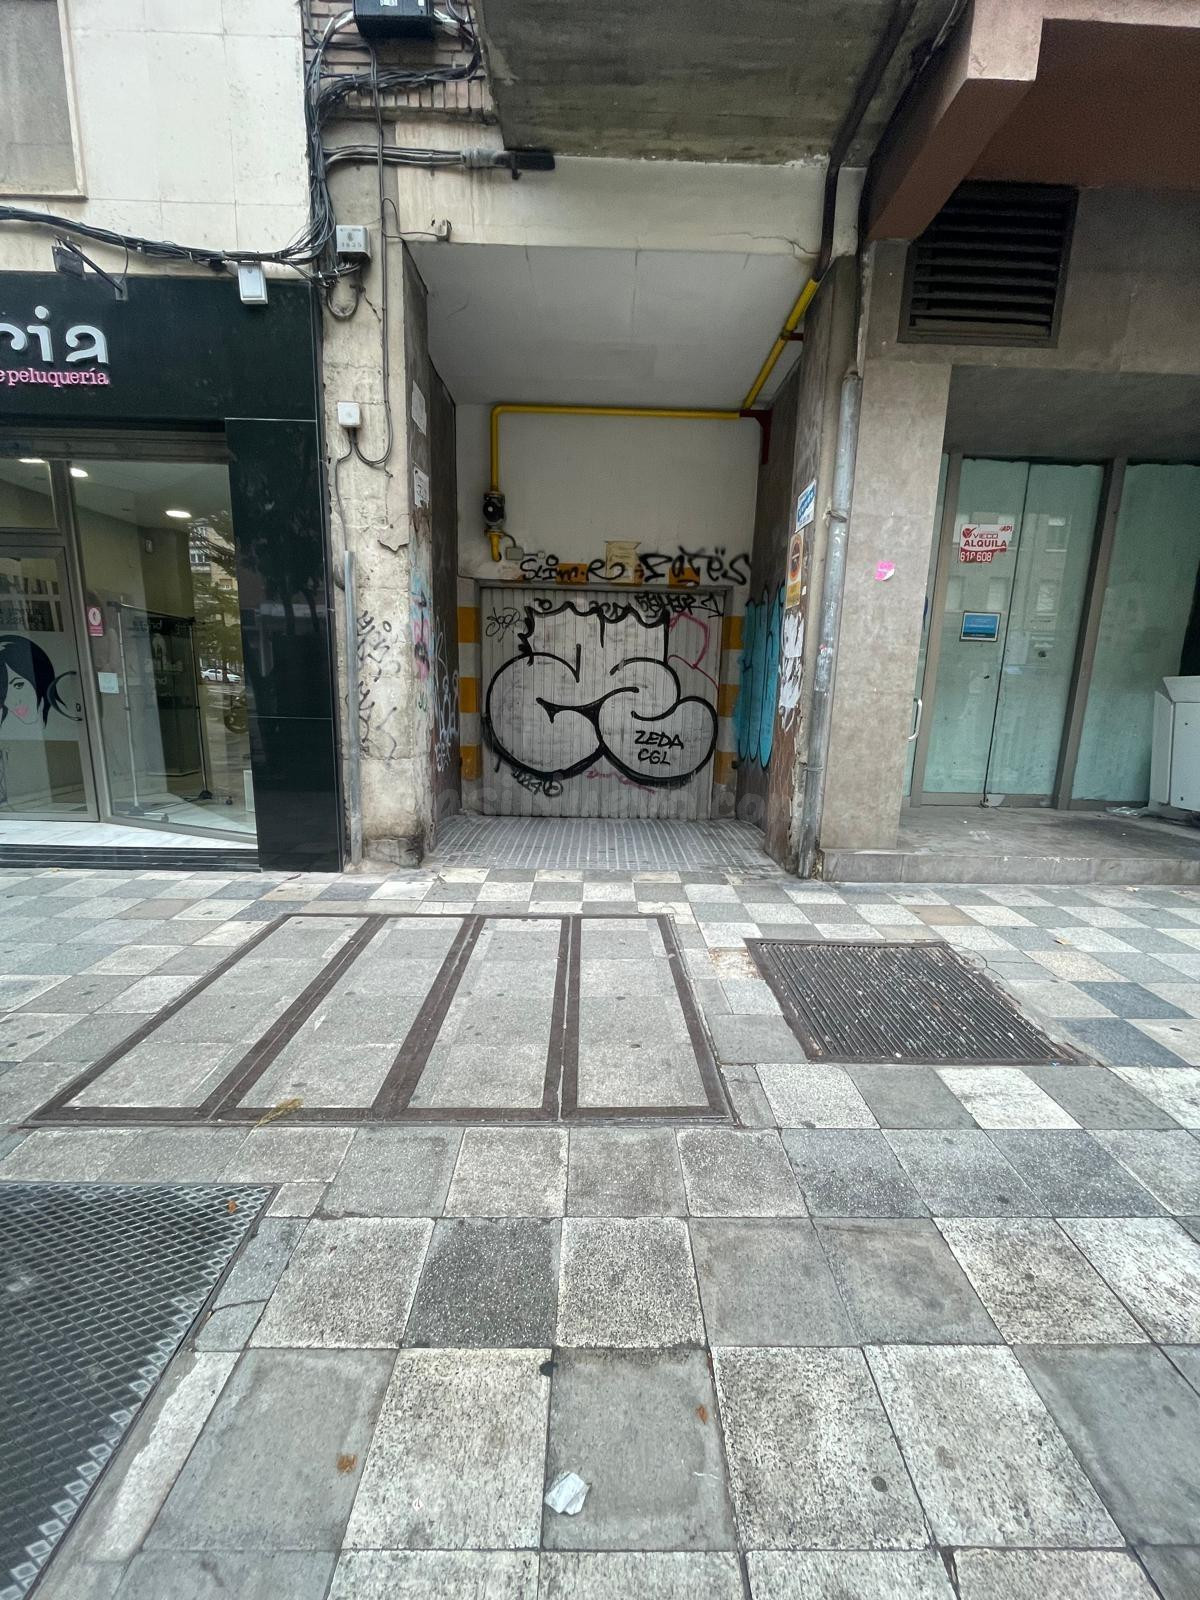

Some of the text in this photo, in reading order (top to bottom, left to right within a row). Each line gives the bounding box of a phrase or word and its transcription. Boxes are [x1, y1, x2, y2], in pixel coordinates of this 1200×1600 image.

[7, 367, 109, 387] peluquería
[963, 540, 1007, 548] ALQUILA
[976, 551, 993, 562] 608
[634, 730, 684, 749] ZEDA
